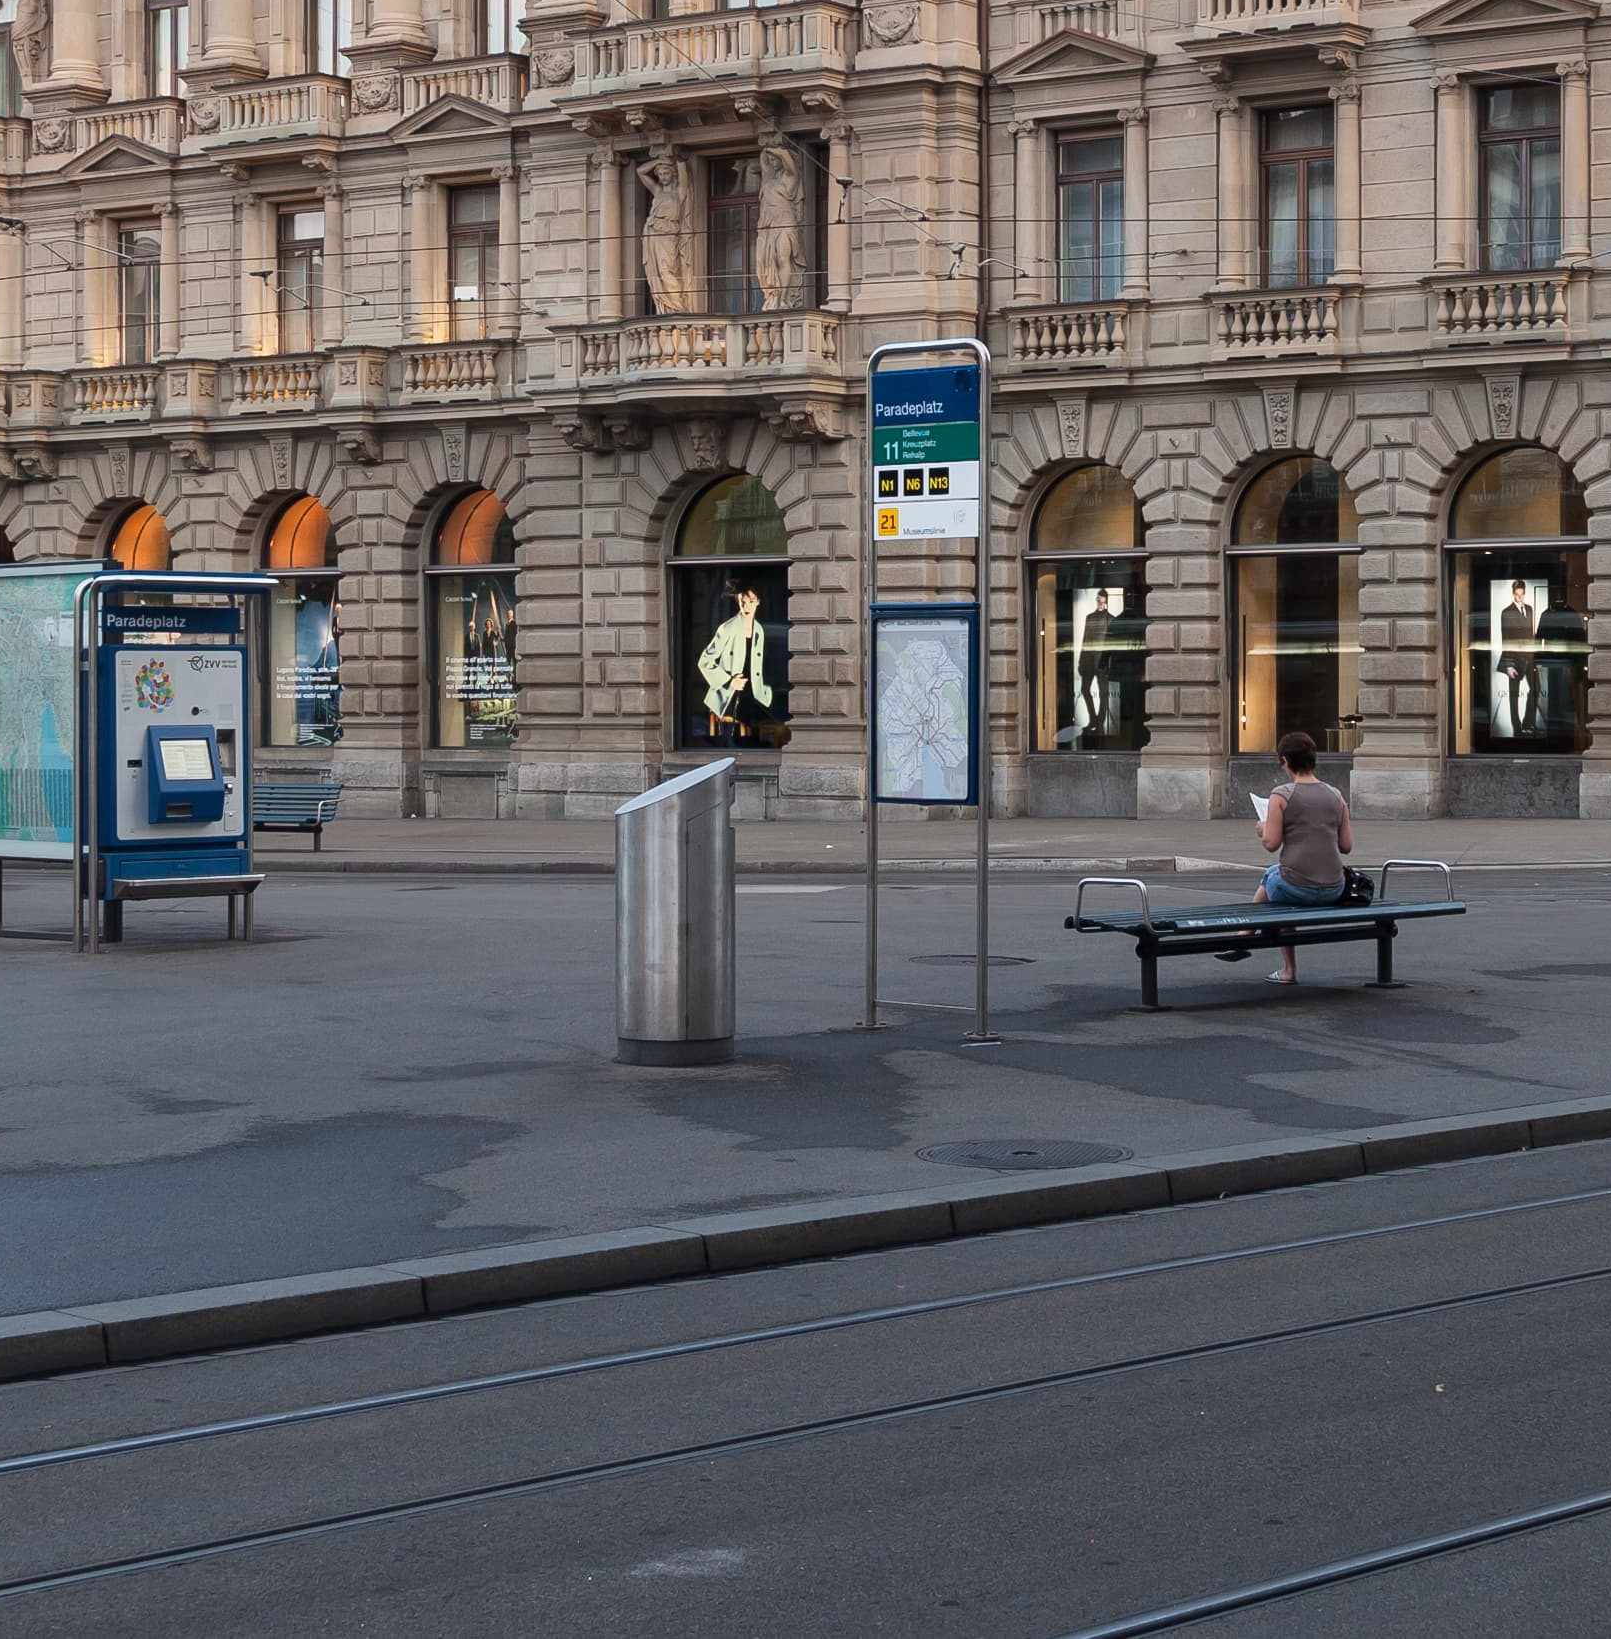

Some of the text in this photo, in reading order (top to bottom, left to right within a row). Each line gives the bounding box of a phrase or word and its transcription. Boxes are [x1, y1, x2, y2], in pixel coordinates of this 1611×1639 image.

[875, 400, 944, 418] Paradeplatz
[902, 429, 930, 438] Bellevue
[883, 441, 899, 460] 11
[902, 439, 937, 450] Kreuzplatz
[902, 450, 926, 460] Rehalp
[881, 479, 895, 492] N1
[906, 479, 921, 491] N6
[929, 477, 949, 490] N13
[880, 514, 896, 530] 21
[106, 613, 186, 630] Paradeplatz
[205, 659, 221, 669] ZVV
